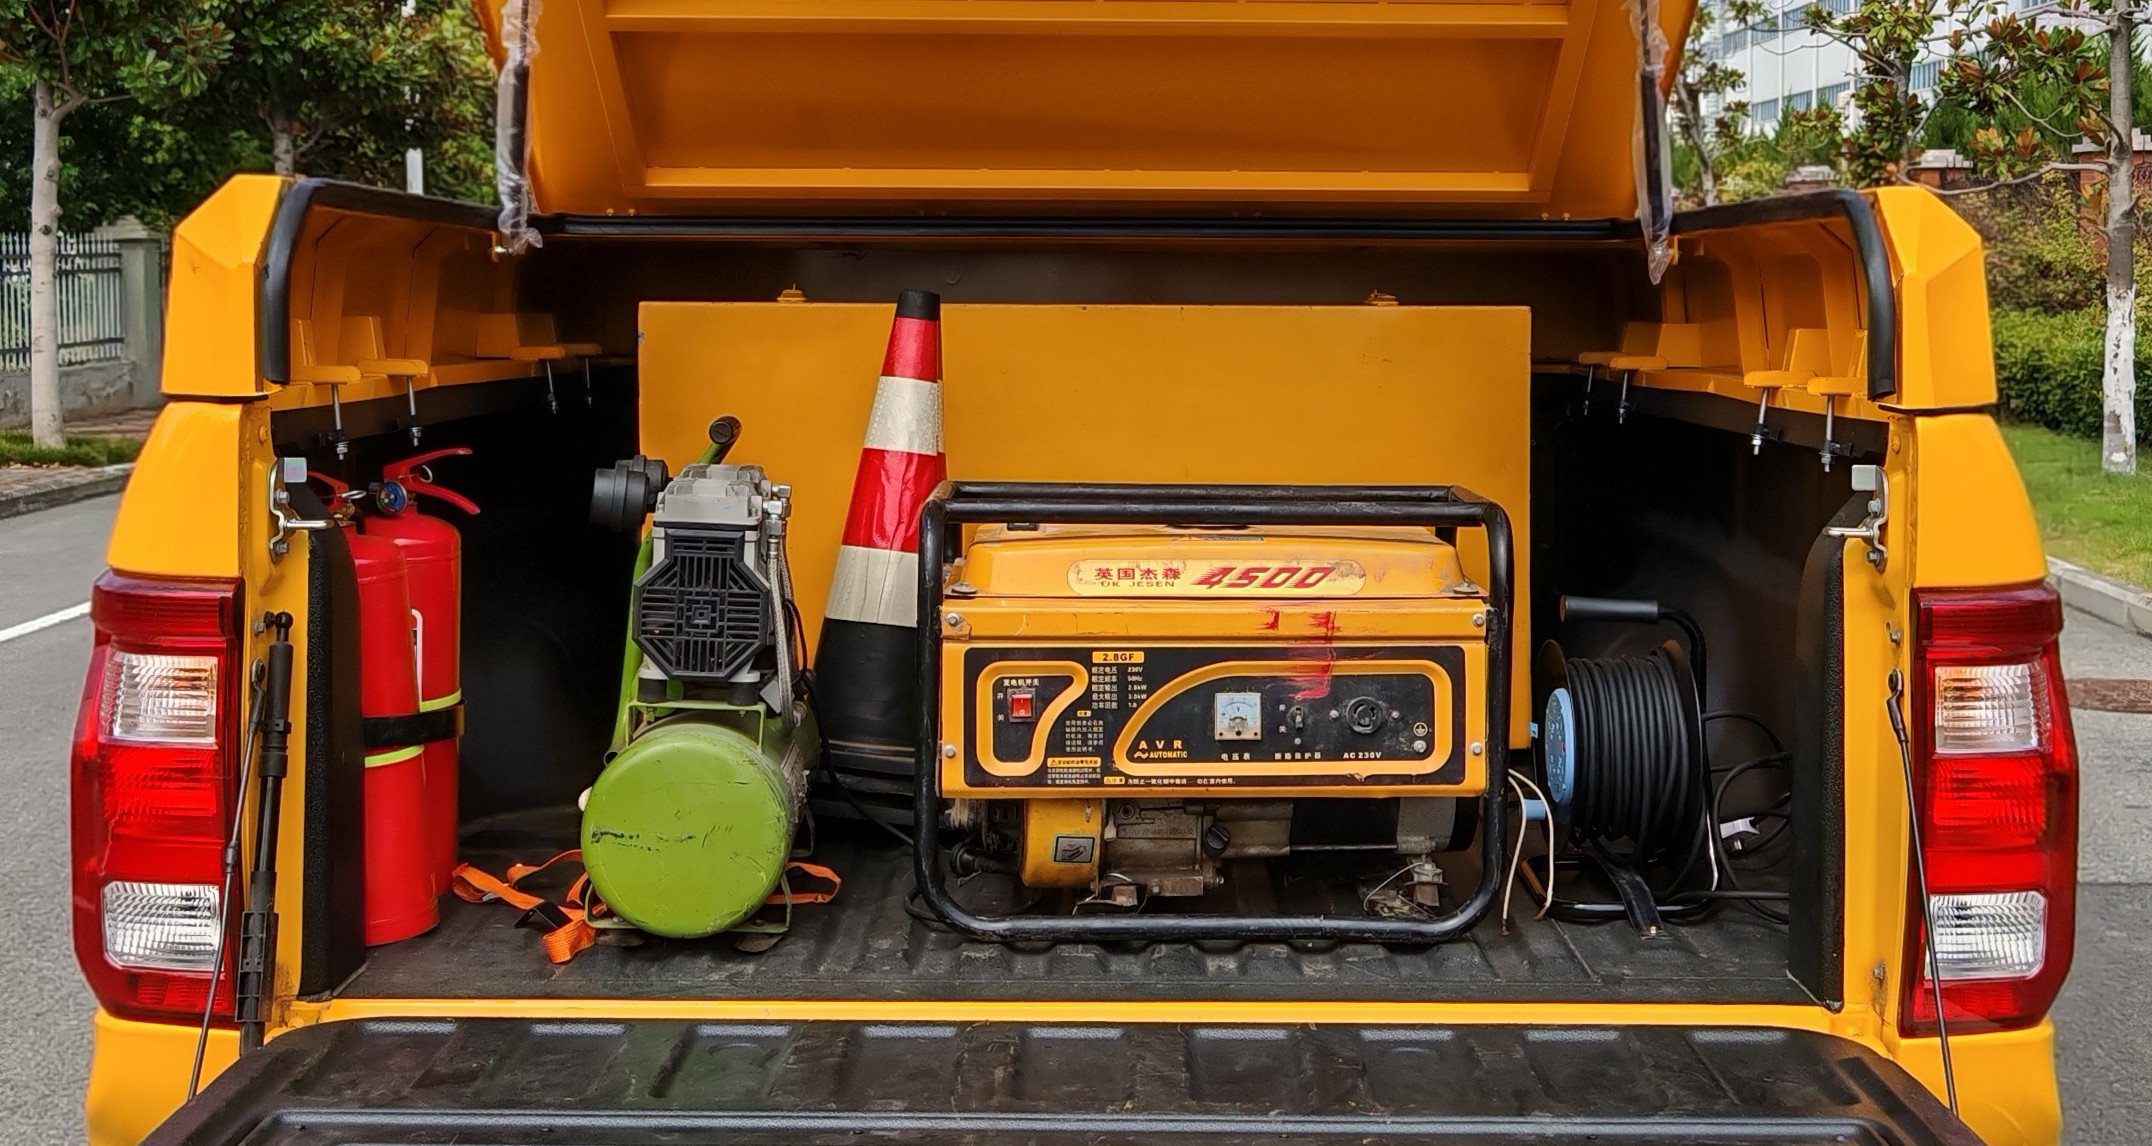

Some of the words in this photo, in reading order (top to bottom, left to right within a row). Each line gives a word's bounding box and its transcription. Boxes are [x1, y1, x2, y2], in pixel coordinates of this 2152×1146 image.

[1094, 567, 1181, 580] 英国杰森
[1190, 566, 1337, 589] 4500
[1128, 580, 1175, 588] JESEN
[1102, 653, 1135, 662] 2.8GF
[1149, 750, 1188, 759] AUTOMATIC
[1221, 752, 1251, 761] 电压表
[1358, 751, 1382, 759] 230V
